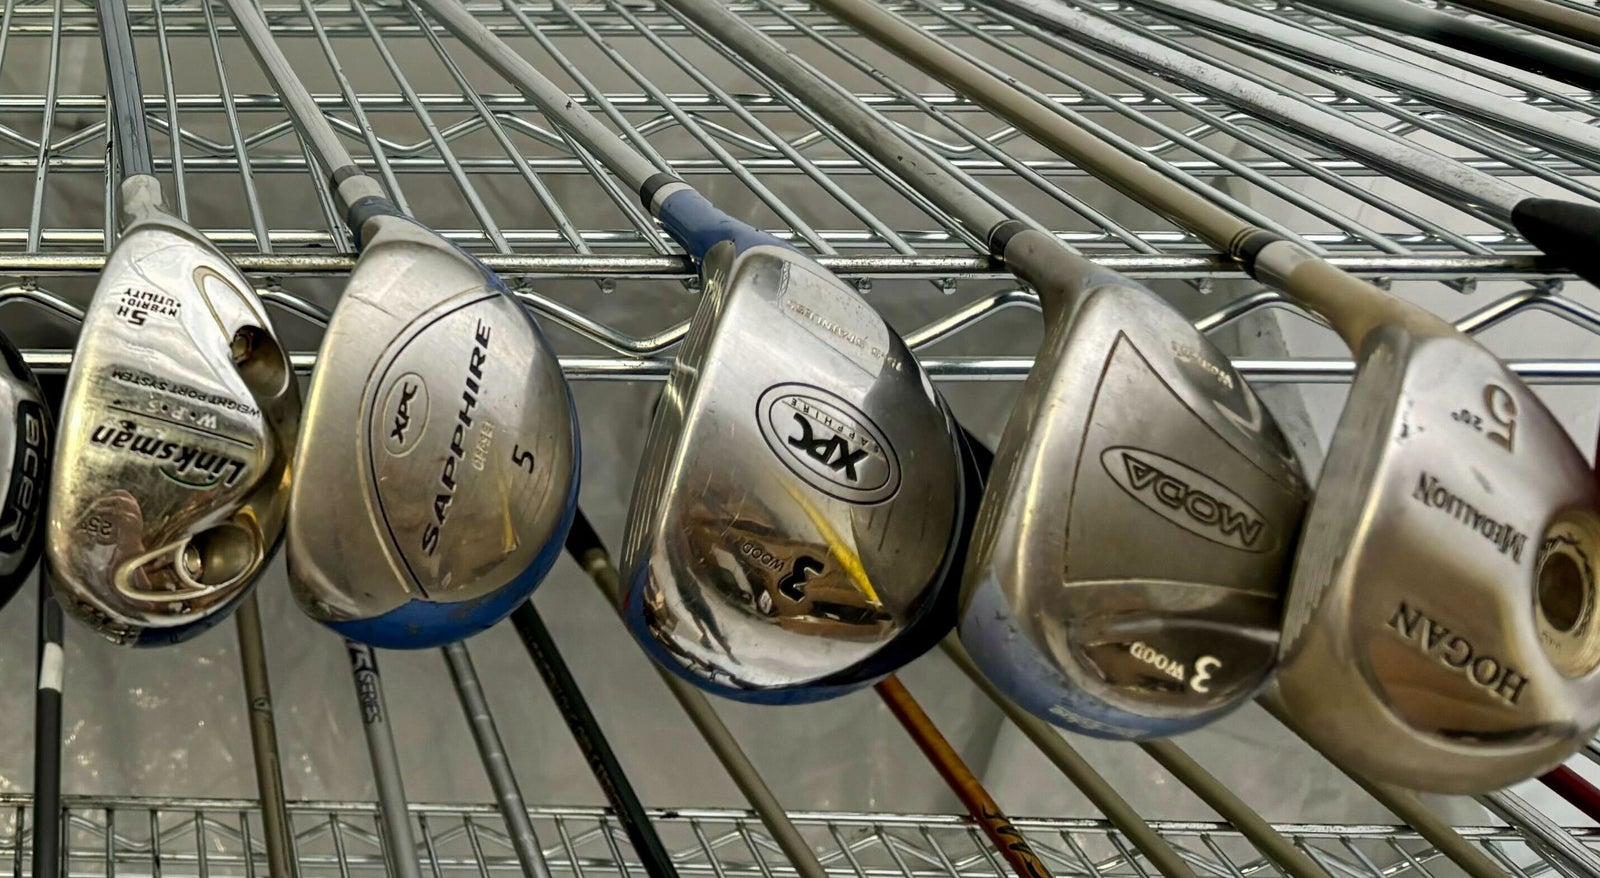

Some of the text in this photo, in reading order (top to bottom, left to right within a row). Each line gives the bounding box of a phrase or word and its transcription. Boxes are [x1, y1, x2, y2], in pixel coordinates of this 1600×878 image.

[111, 369, 167, 392] SYSTEM
[168, 381, 209, 403] PORT
[390, 381, 418, 444] XPC
[422, 317, 492, 556] SAPPHIRE
[790, 397, 880, 453] SAPPHIRE
[1482, 382, 1520, 454] 5
[91, 423, 248, 488] Linksman
[511, 444, 535, 474] 5
[788, 411, 869, 483] XPC
[1120, 453, 1265, 546] MODA
[742, 541, 824, 602] 3 WOOD
[1129, 641, 1223, 693] 3 WOOD
[1388, 603, 1529, 705] HOGAN
